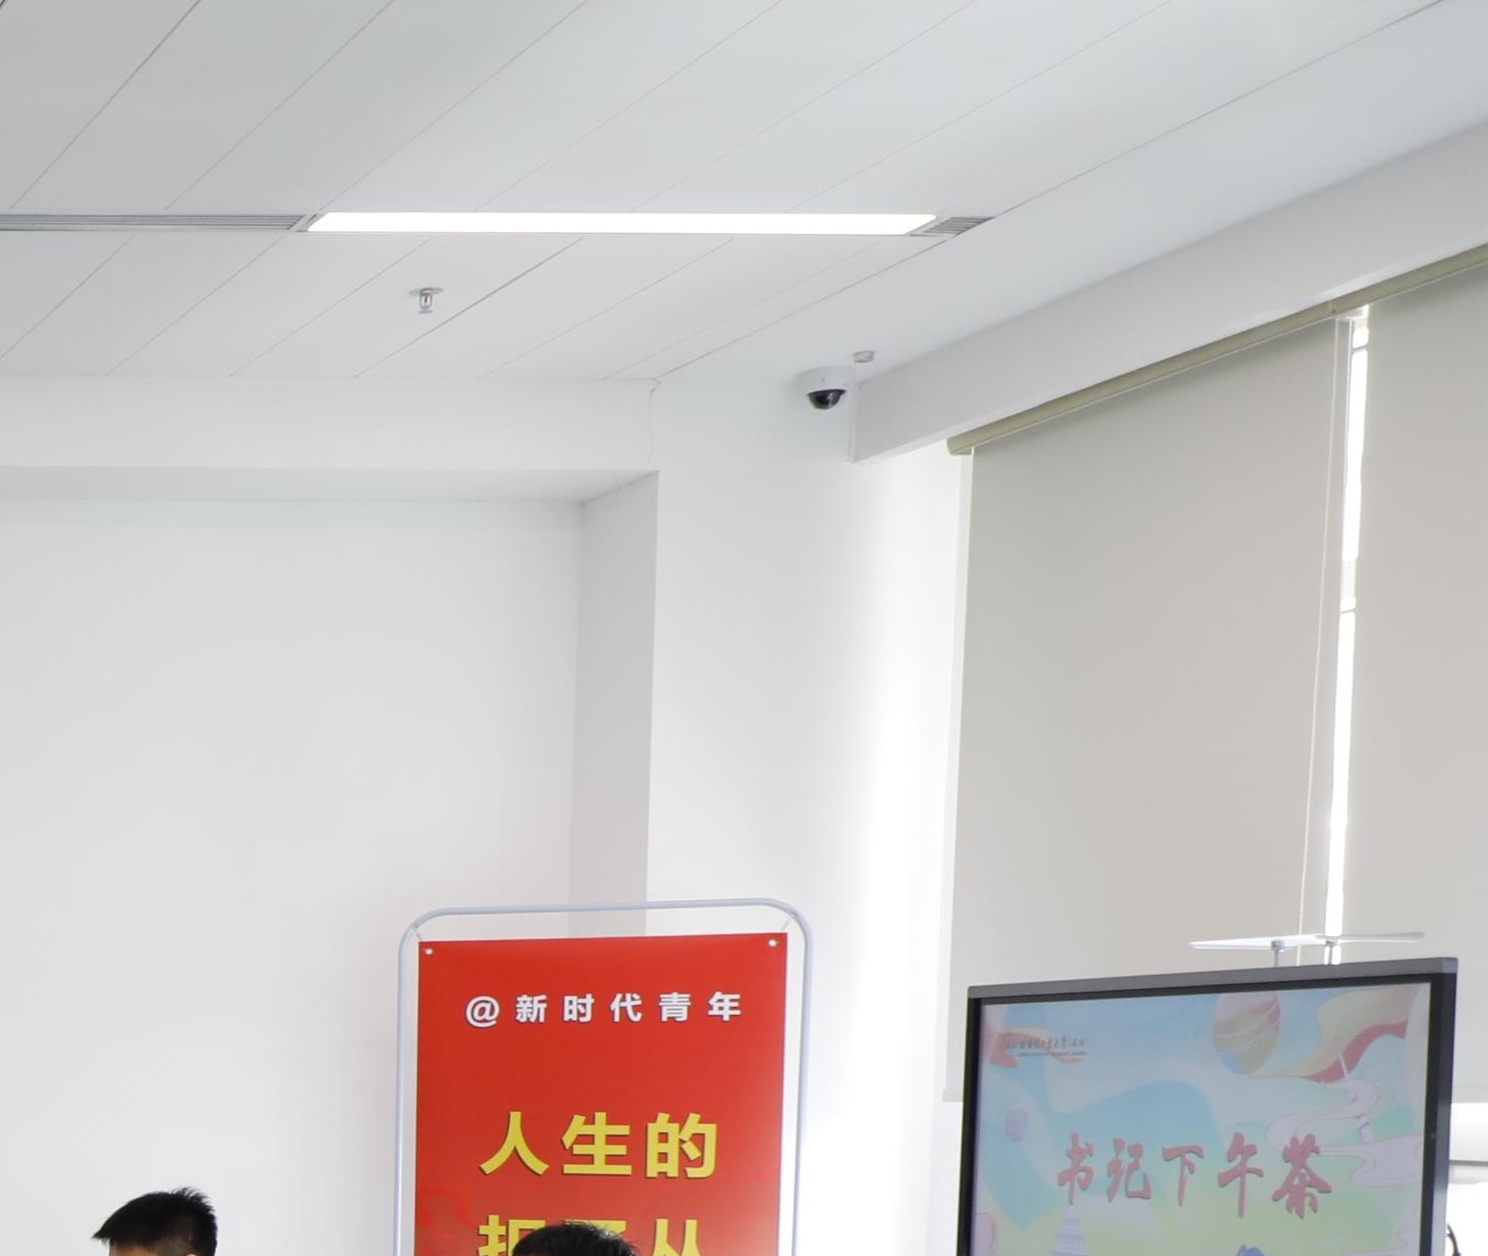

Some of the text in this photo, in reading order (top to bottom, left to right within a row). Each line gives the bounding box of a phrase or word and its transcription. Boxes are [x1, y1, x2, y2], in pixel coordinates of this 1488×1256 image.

[465, 991, 742, 1028] @新时代青年
[480, 1110, 718, 1180] 人生的
[1057, 1131, 1332, 1219] 书记下午茶
